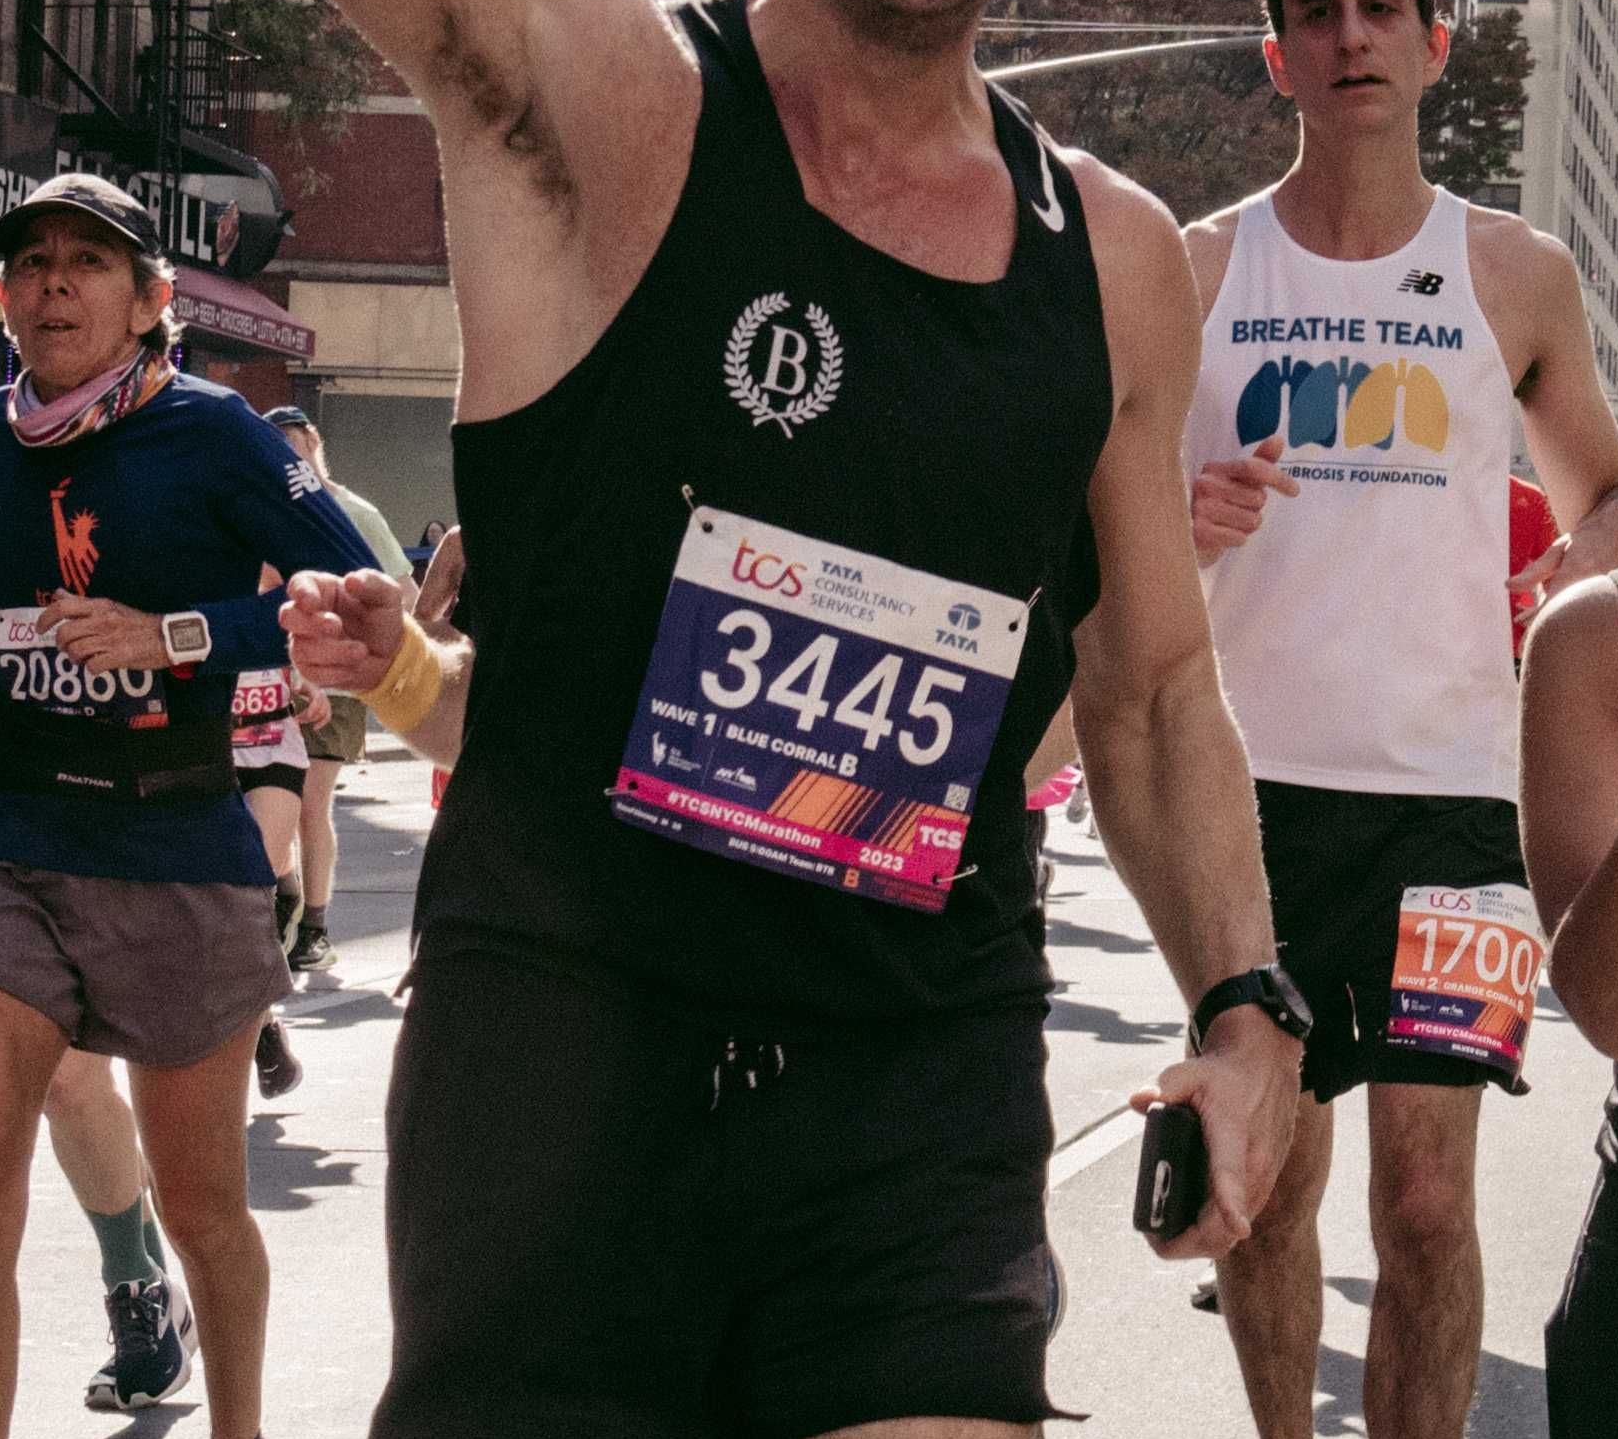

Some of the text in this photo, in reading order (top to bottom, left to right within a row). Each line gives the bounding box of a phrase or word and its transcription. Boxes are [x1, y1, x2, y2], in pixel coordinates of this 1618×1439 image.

[199, 302, 216, 326] BEER
[1231, 317, 1463, 350] BREATHE TEAM
[760, 324, 808, 396] B
[1349, 470, 1447, 487] FOUNDATION
[731, 537, 809, 598] tcs
[819, 559, 864, 583] TATA
[809, 592, 877, 623] SERVICES
[813, 576, 918, 618] CONSULTANCY
[934, 628, 980, 654] TATA
[699, 608, 968, 766] 3445
[651, 698, 860, 777] WAVE 1 BLUE CORRAL B
[666, 790, 823, 850] #TCSNYCMarathon
[859, 846, 905, 873] 2023
[919, 824, 963, 851] TCS
[1478, 889, 1504, 899] TATA
[1398, 974, 1425, 987] WAVE
[1428, 977, 1439, 992] 2
[1443, 981, 1484, 997] ORANGE
[1414, 1022, 1503, 1049] #TCSNYCMarathon
